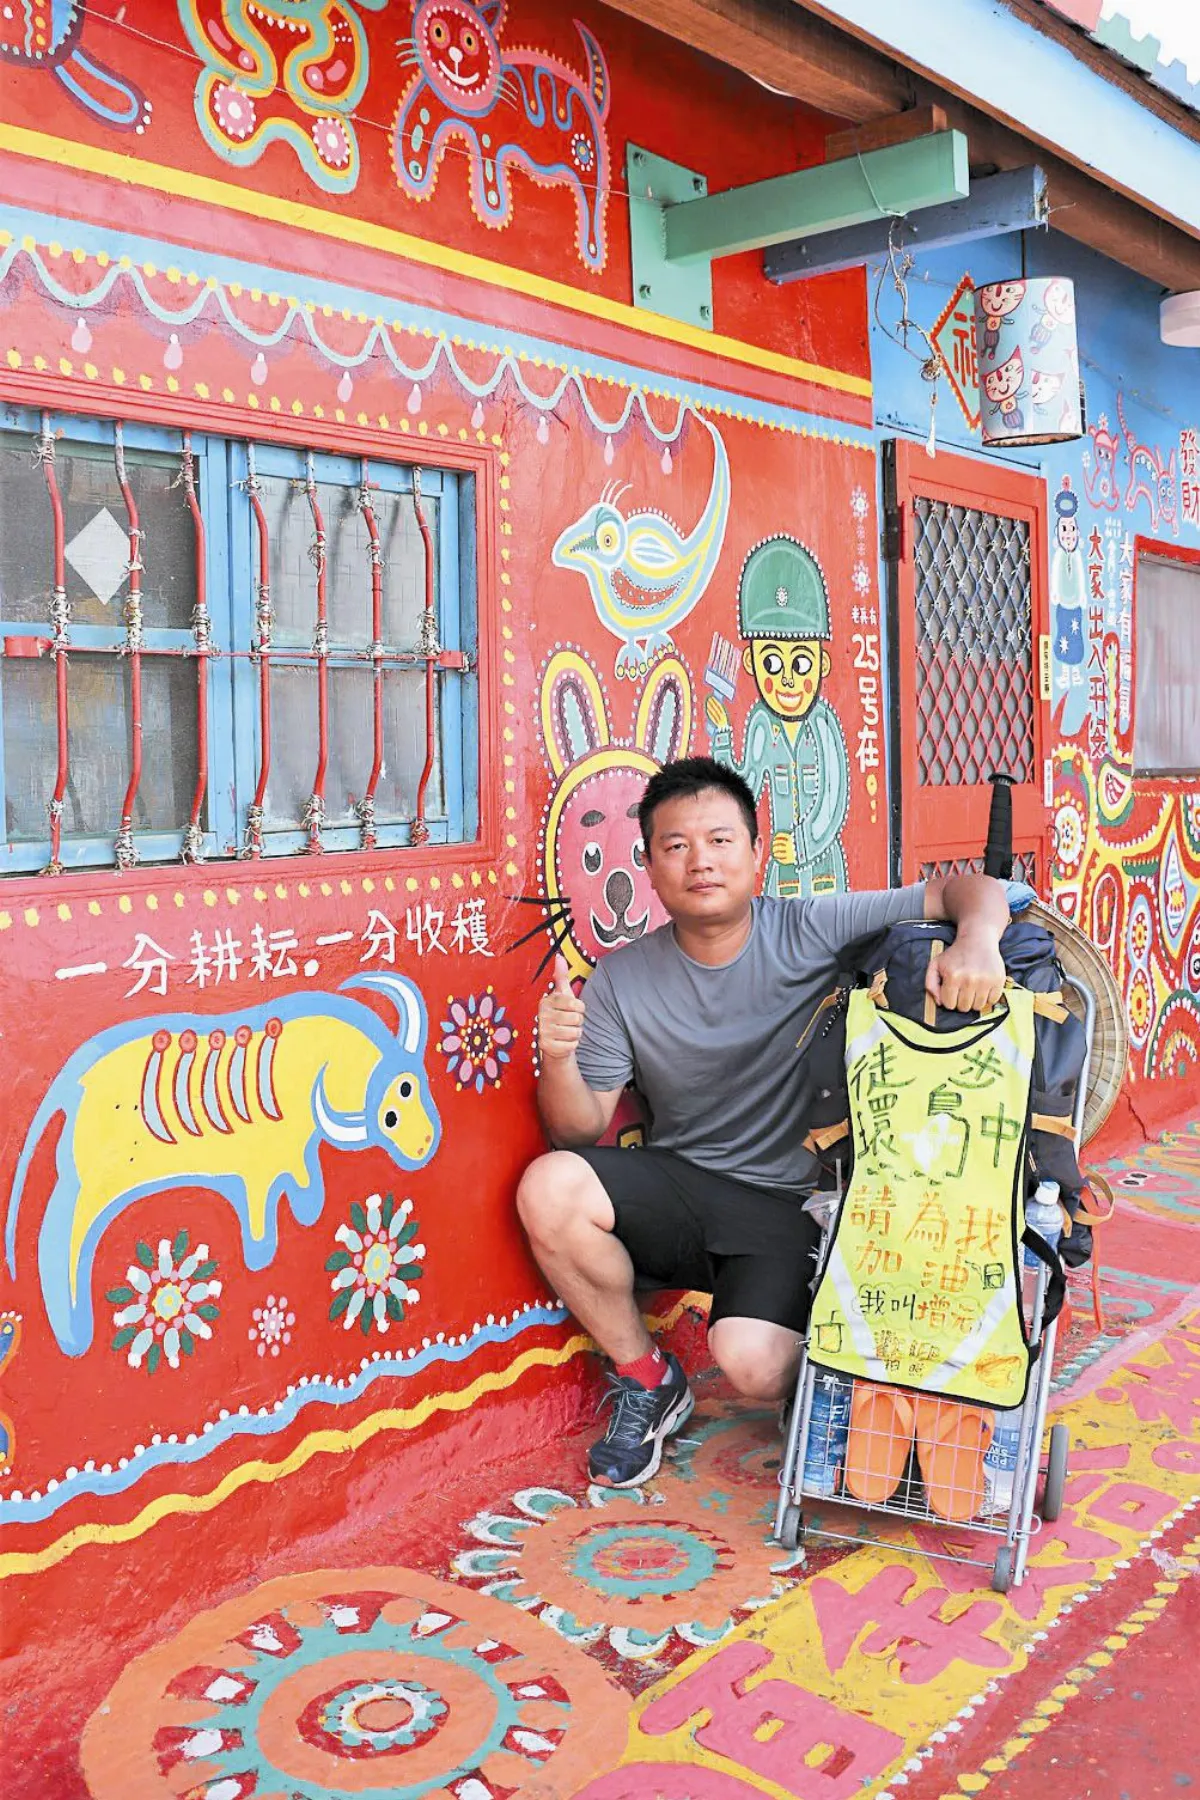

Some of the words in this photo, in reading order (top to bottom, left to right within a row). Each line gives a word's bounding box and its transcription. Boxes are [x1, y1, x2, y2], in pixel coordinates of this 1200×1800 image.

[1180, 428, 1200, 526] 發財
[1087, 524, 1108, 758] 大家出入平安
[850, 1042, 1004, 1101] 徒步
[850, 1184, 1006, 1256] 請為我
[855, 1240, 969, 1293] 加油
